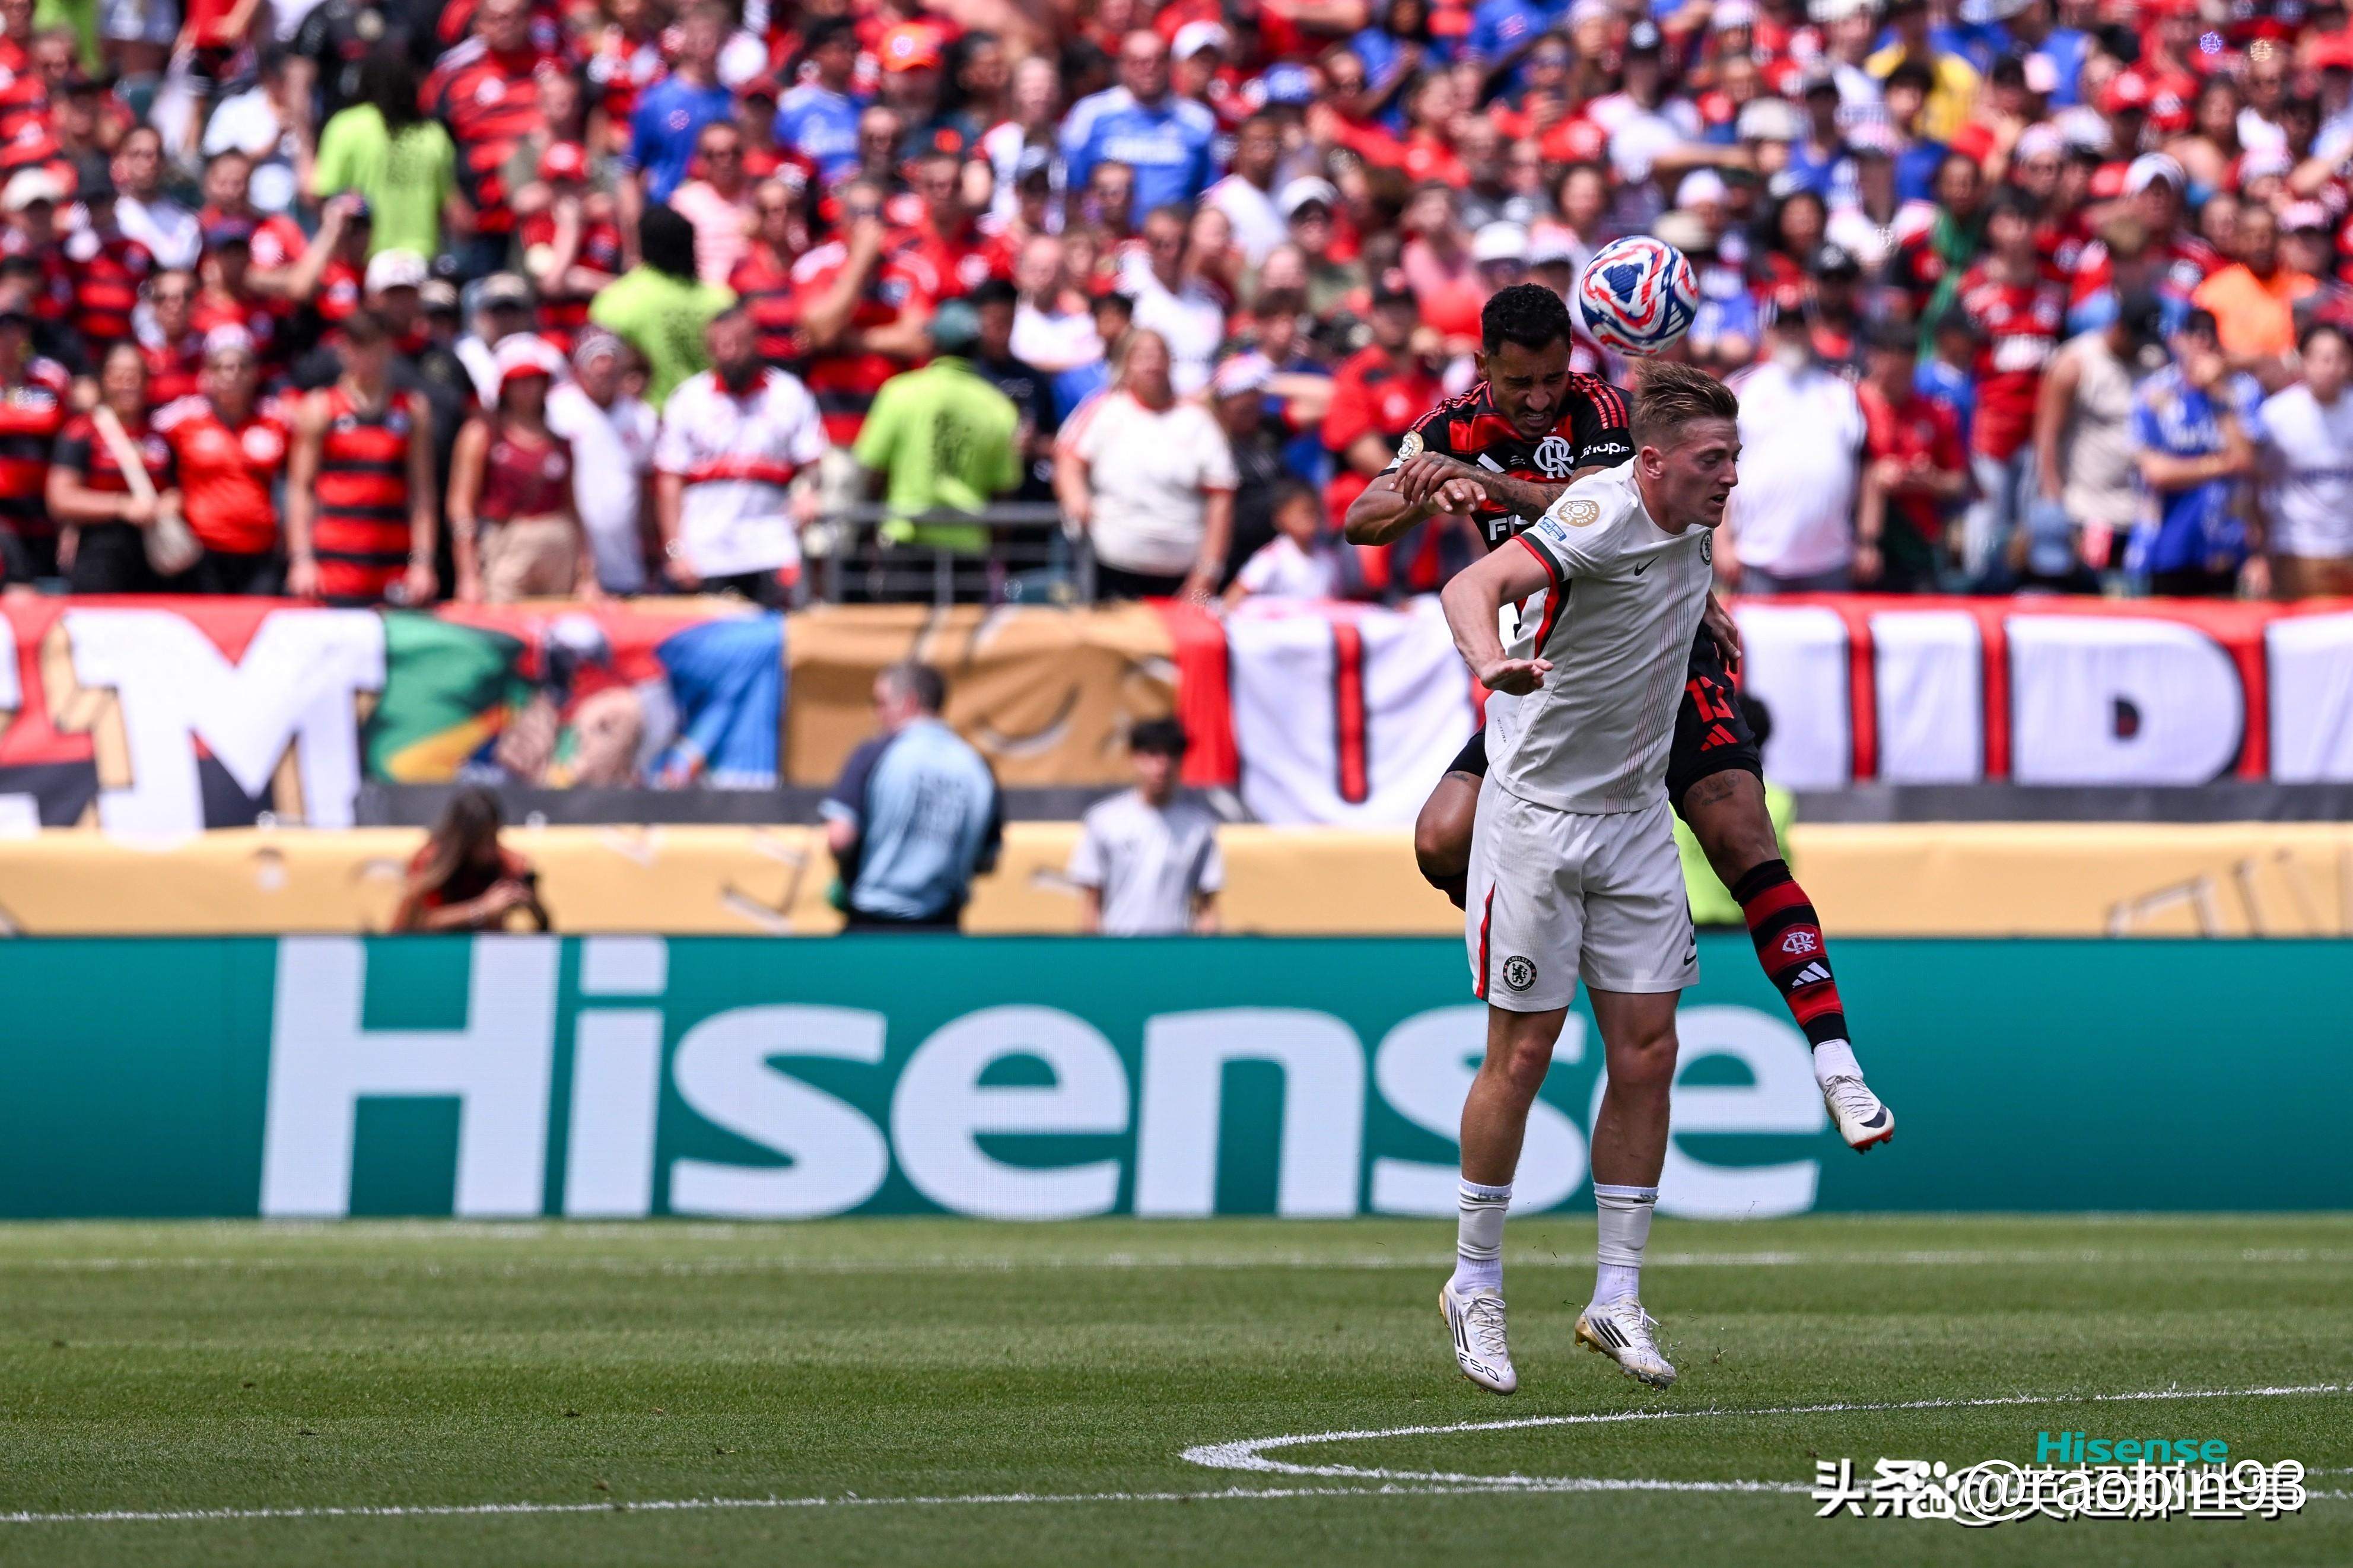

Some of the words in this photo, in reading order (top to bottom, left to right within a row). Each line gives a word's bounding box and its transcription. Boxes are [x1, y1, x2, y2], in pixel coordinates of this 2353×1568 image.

[1508, 956, 1531, 966] CHELSEA
[259, 935, 1827, 1220] Hisense
[1458, 1352, 1499, 1382] F50
